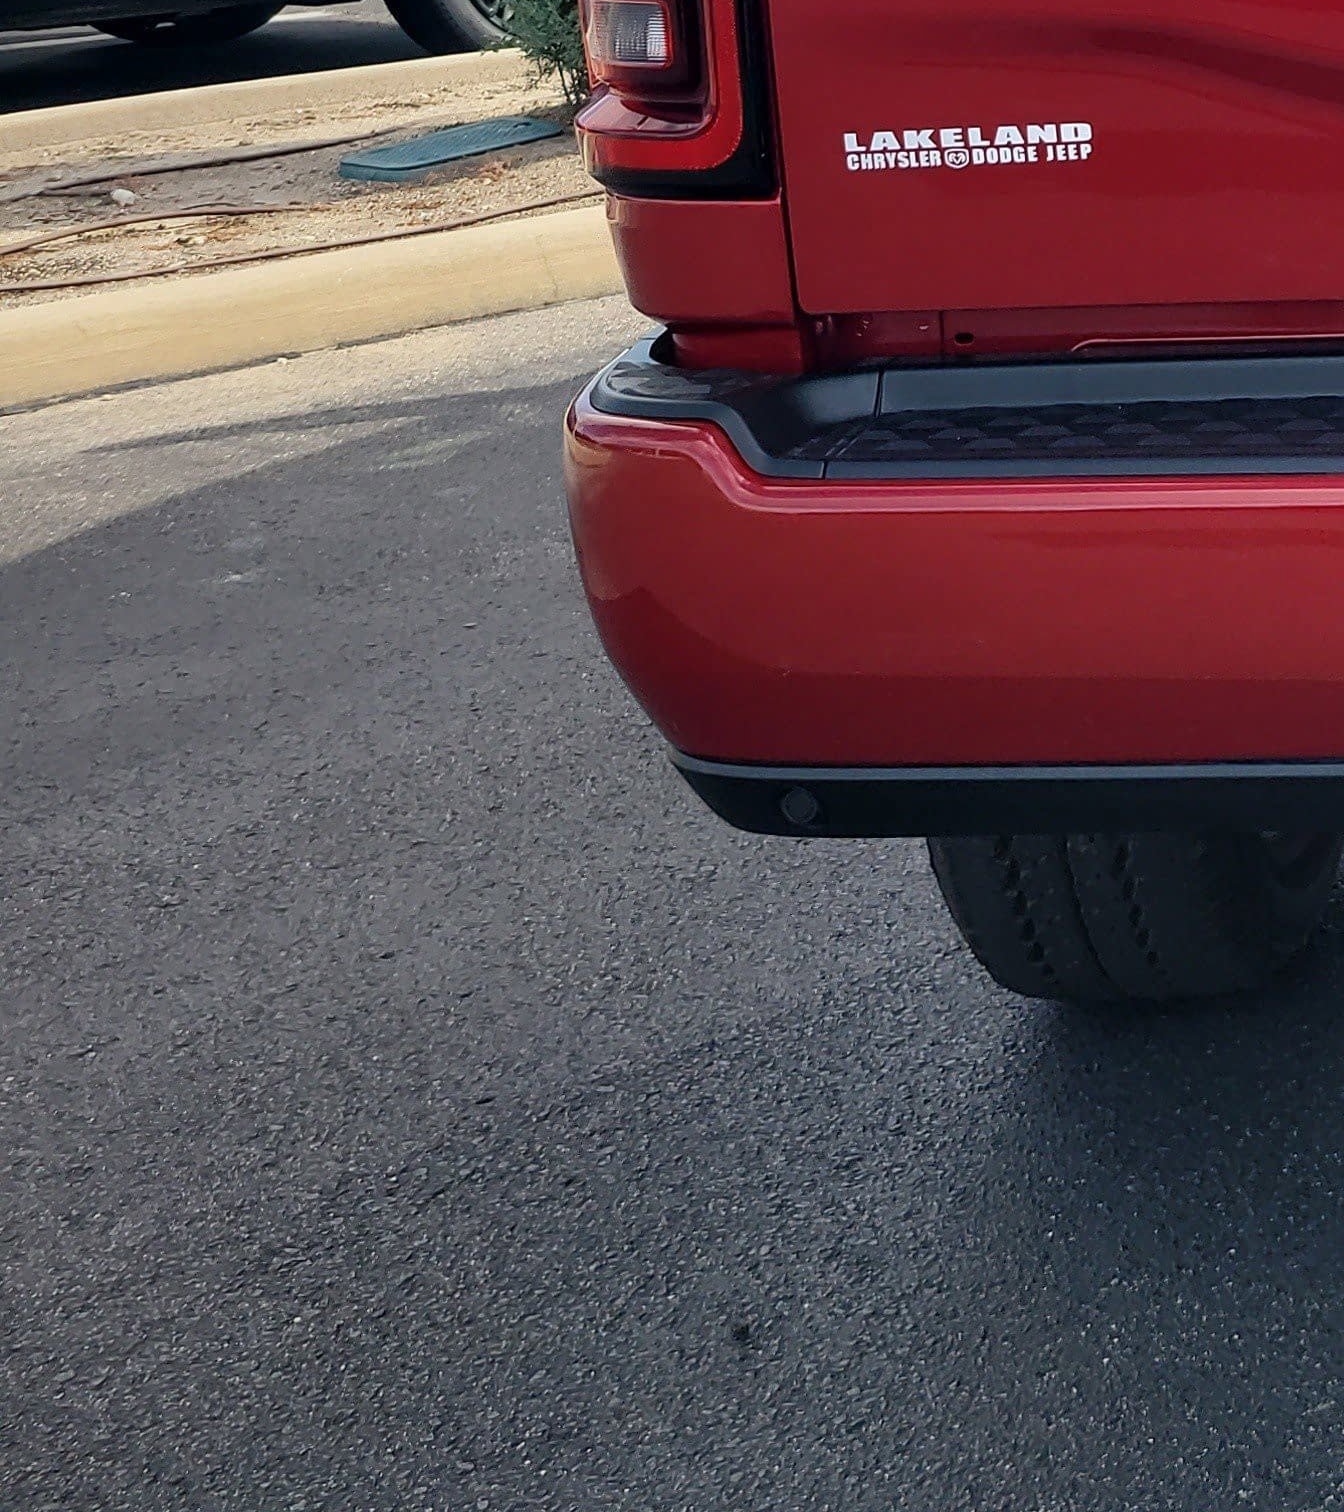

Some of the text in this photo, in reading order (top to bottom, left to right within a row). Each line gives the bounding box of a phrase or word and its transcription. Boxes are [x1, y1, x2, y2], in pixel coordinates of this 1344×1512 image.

[843, 122, 1094, 152] LAKELAND
[846, 143, 1093, 171] CHRYSLER DODGE JEEP
